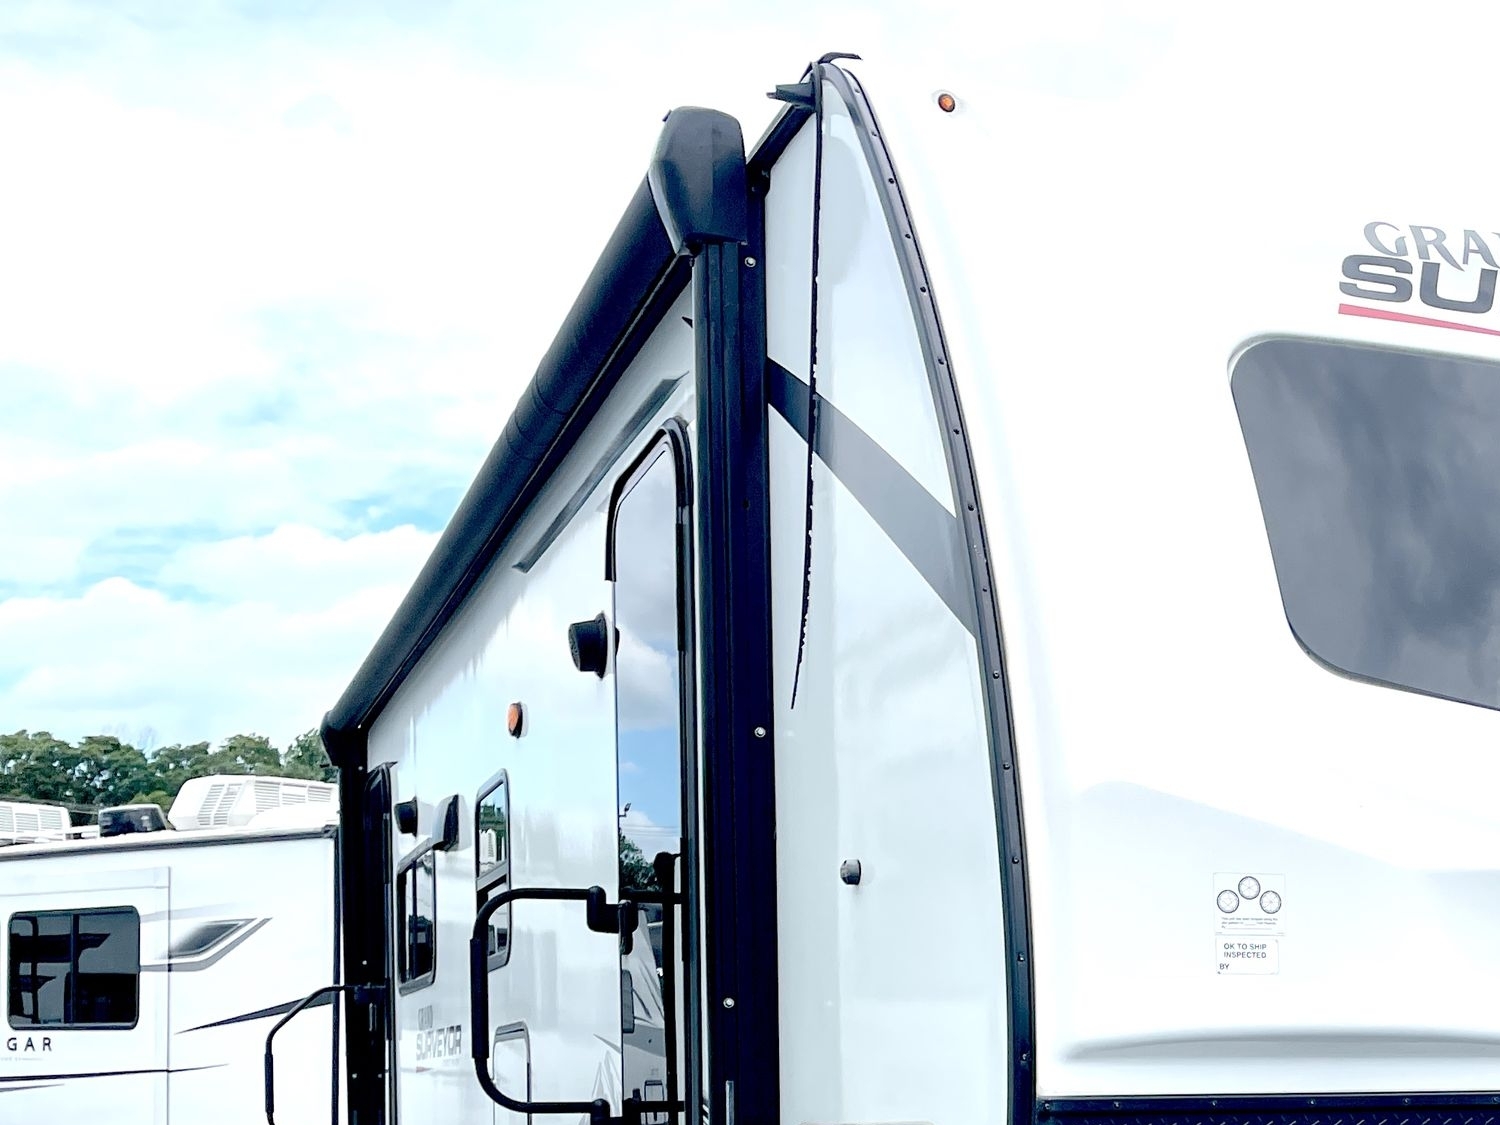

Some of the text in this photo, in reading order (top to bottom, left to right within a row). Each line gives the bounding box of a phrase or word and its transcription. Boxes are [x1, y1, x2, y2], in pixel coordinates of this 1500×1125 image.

[1223, 942, 1267, 951] OK TO SHIP
[1223, 951, 1267, 959] INSPECTED
[1219, 962, 1230, 970] BY
[6, 1036, 53, 1052] GAR
